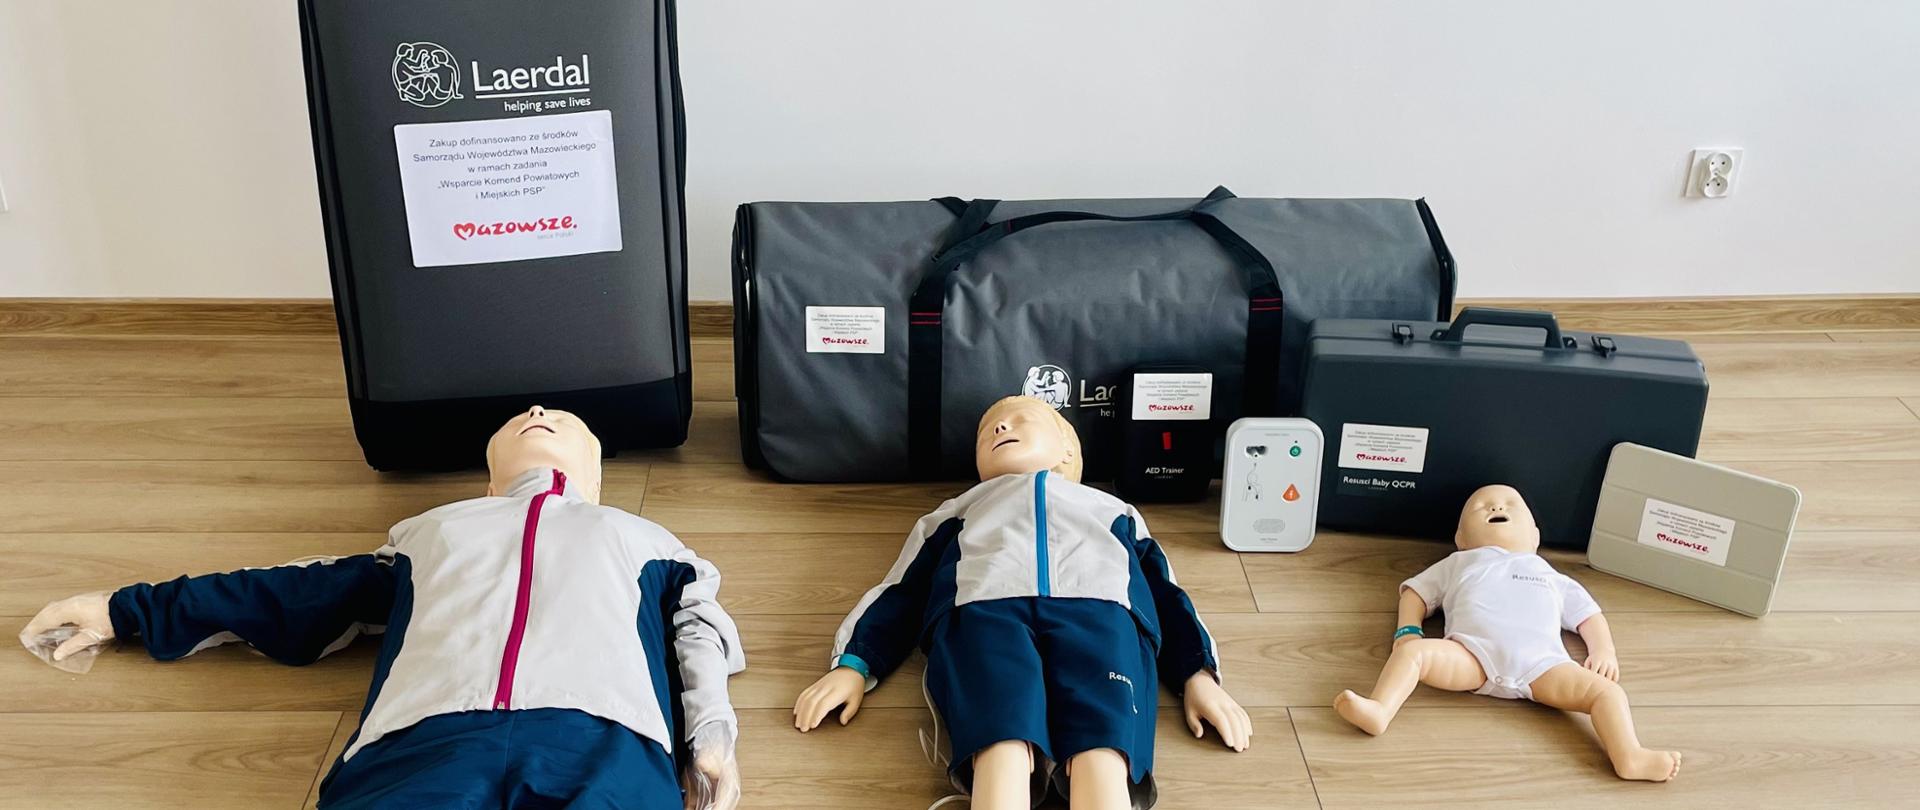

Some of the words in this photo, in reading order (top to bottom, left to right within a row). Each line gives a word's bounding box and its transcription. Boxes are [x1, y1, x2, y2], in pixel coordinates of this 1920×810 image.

[471, 54, 590, 91] Laerdal
[504, 101, 542, 114] helping
[545, 99, 566, 109] save
[569, 97, 591, 107] lives
[429, 139, 457, 147] Zakup
[460, 135, 527, 146] dofinansowano
[542, 130, 578, 140] środków
[413, 151, 465, 162] Samorządu
[467, 148, 528, 160] Województwa
[530, 143, 596, 155] Mazowieckiego
[477, 163, 511, 172] ramach
[513, 160, 548, 170] zadania
[484, 175, 521, 185] Komend
[523, 170, 580, 182] Powiatowych
[480, 189, 521, 200] Miejskich
[1145, 466, 1161, 474] AED
[1161, 466, 1184, 474] Trainer
[1343, 476, 1371, 485] Resusci
[1372, 478, 1391, 488] Baby
[1391, 480, 1416, 489] QCPR
